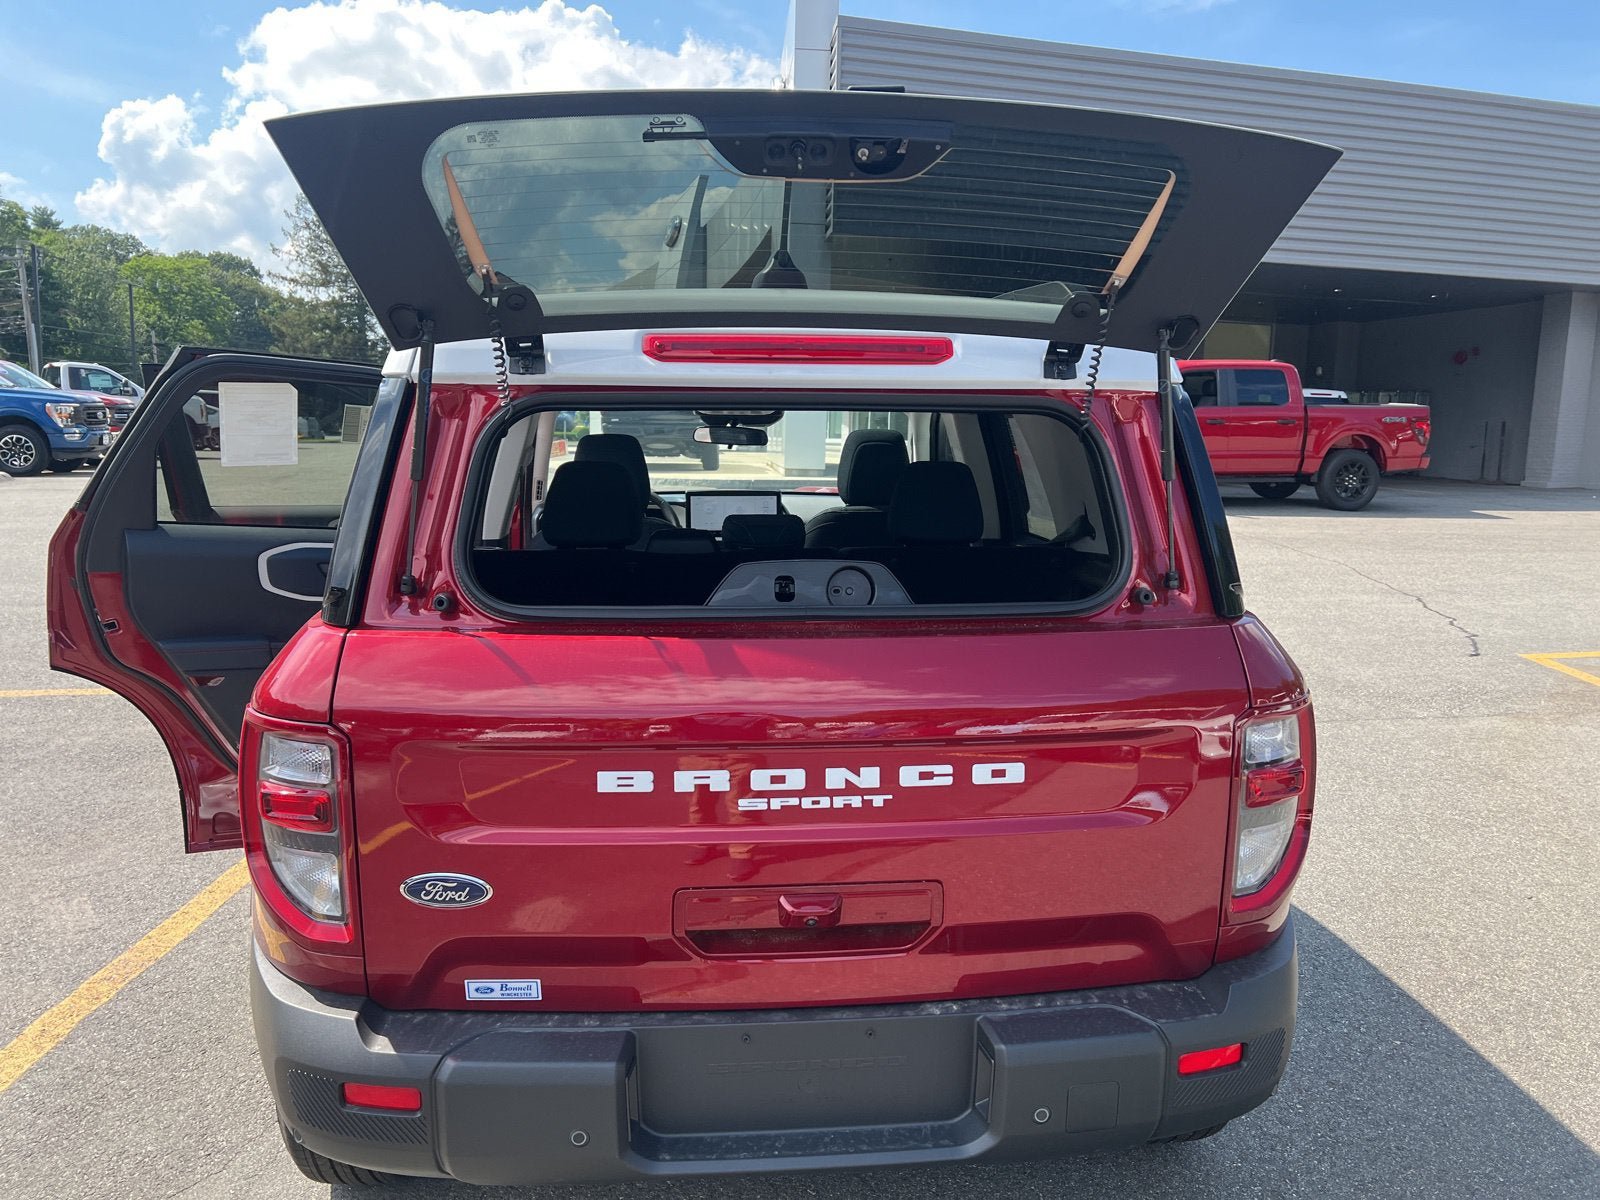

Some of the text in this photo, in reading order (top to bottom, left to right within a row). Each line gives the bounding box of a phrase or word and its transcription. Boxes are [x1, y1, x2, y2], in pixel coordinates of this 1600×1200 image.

[596, 762, 1025, 793] BRONCO
[737, 794, 893, 811] SPORT
[420, 880, 470, 902] Ford
[499, 983, 532, 992] Bonnell
